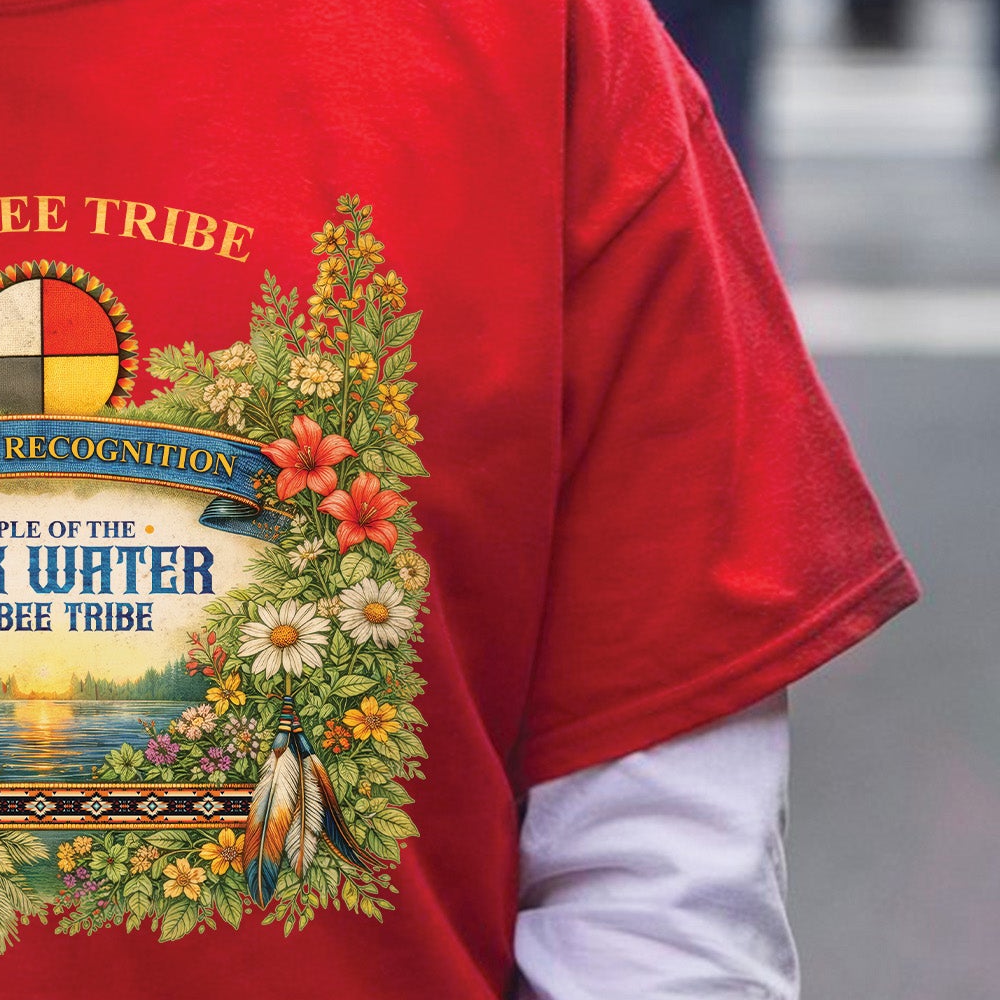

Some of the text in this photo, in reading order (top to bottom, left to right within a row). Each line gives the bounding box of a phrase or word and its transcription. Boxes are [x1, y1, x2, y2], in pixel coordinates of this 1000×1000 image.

[85, 197, 255, 263] TRIBE
[5, 435, 238, 478] RECOGNITION
[48, 520, 84, 539] OF
[86, 520, 136, 539] THE
[26, 545, 216, 596] WATER
[64, 602, 154, 632] TRIBE
